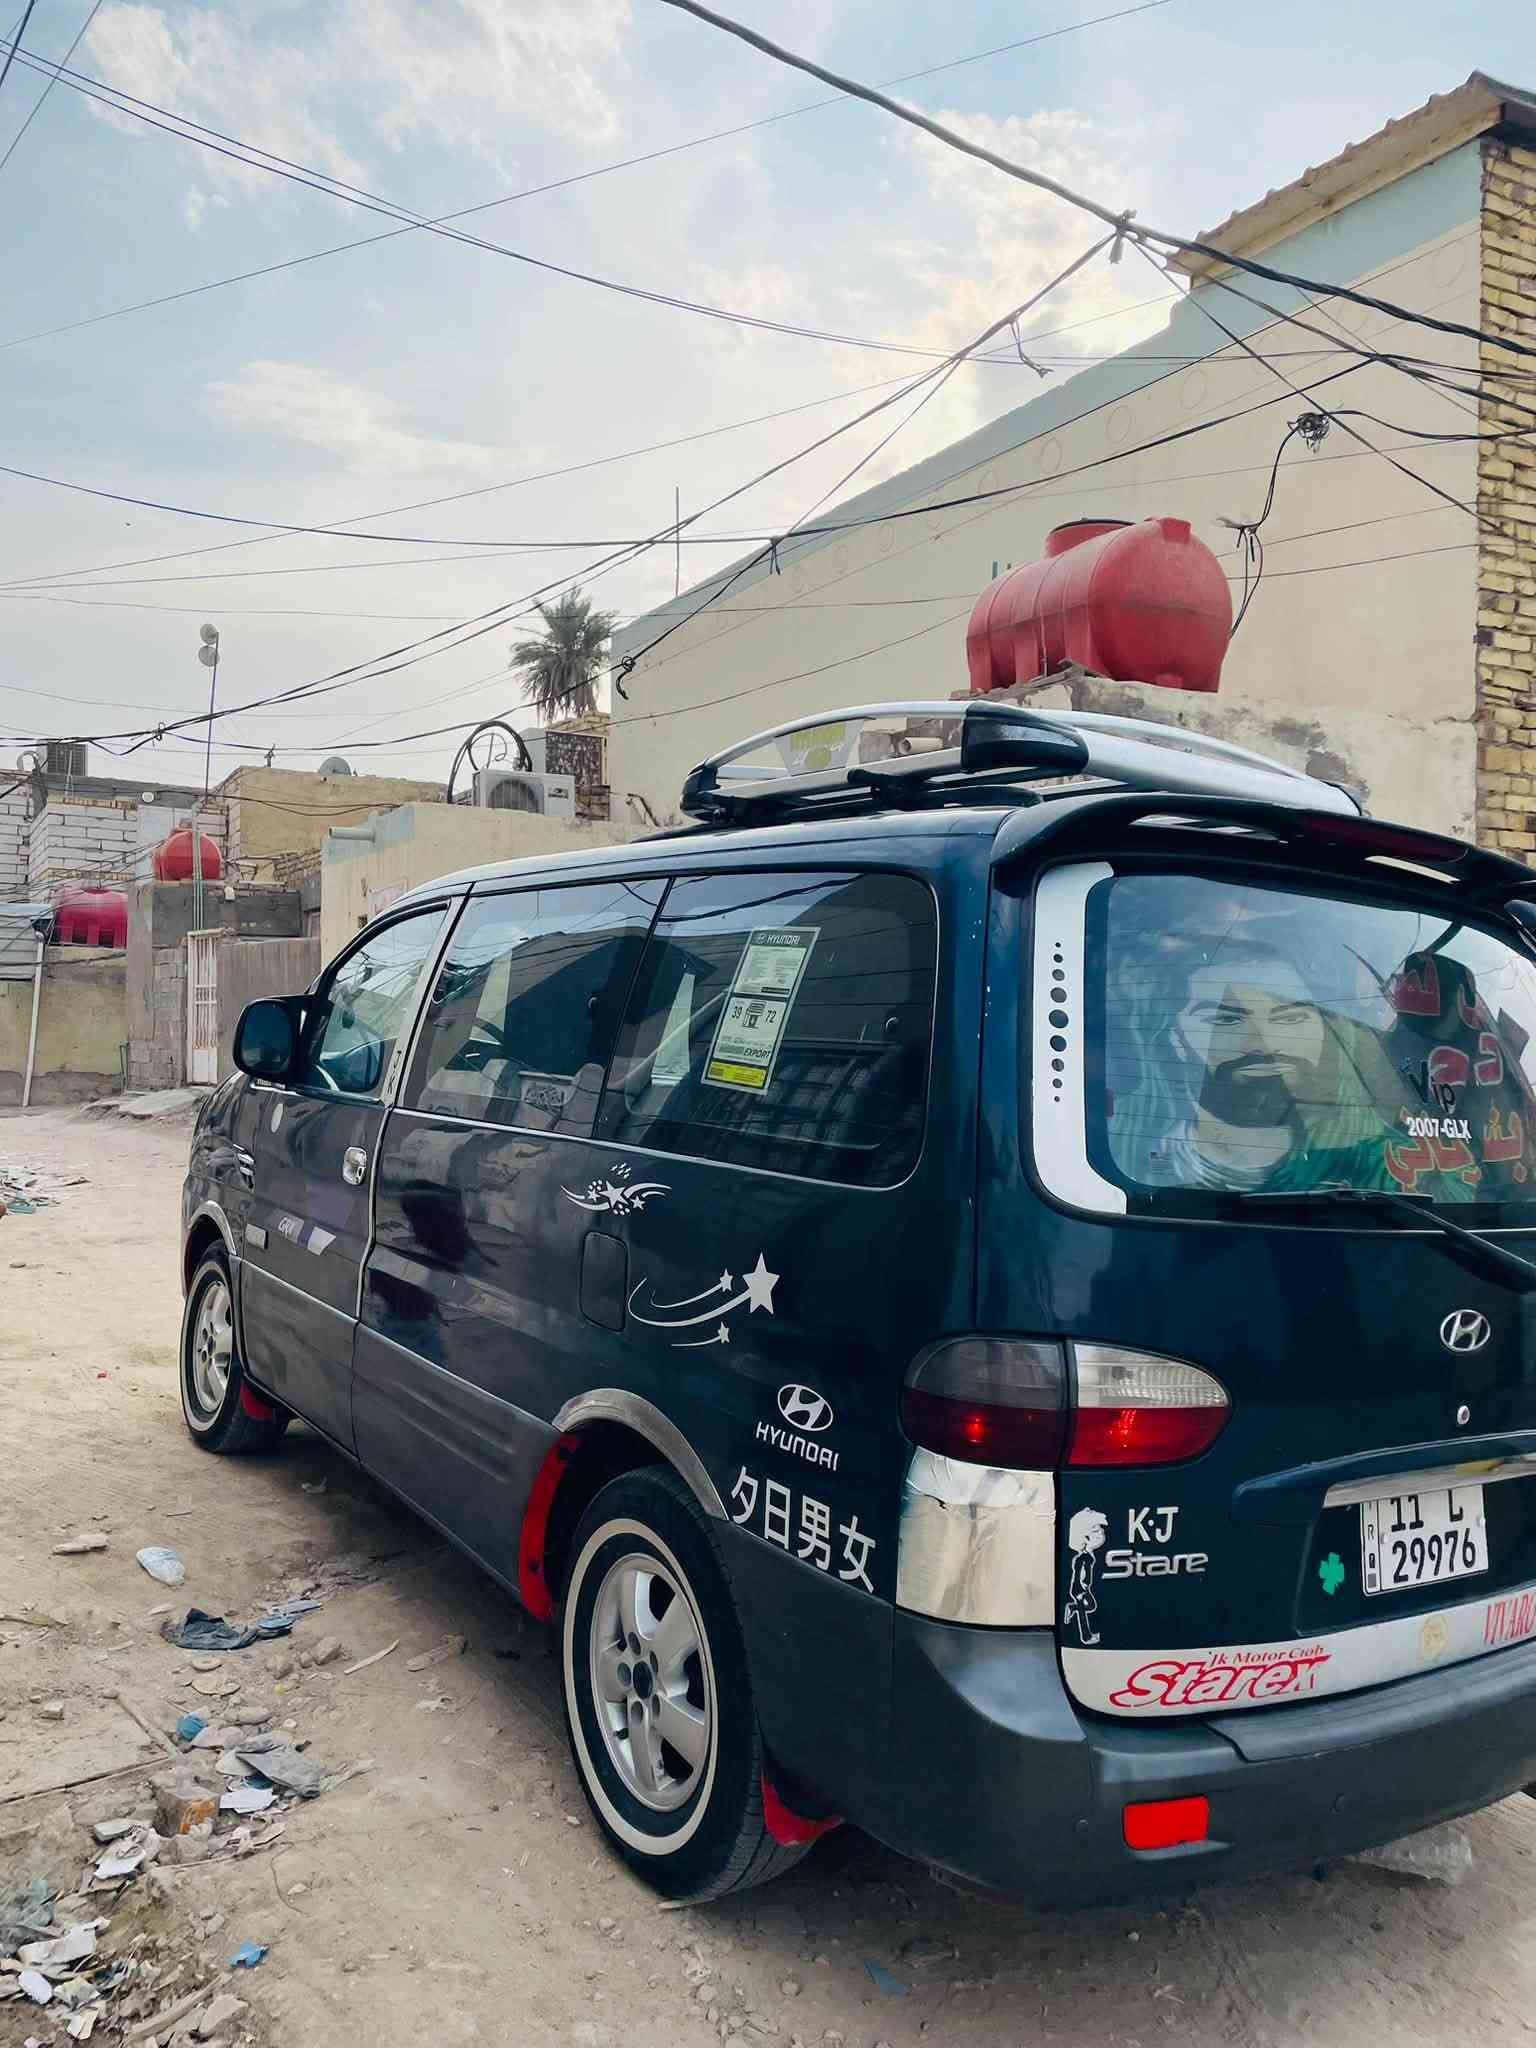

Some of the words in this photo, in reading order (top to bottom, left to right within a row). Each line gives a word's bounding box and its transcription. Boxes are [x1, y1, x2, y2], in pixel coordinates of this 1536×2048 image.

[765, 1009, 777, 1024] 72
[1406, 1116, 1473, 1141] 2007-GLX
[755, 1420, 840, 1472] HYUNDAI
[730, 1465, 877, 1594] 夕日男女
[1390, 1494, 1425, 1533] 11
[1101, 1549, 1209, 1580] Stare
[1391, 1527, 1477, 1584] 29976
[1233, 1651, 1286, 1664] Motor
[1108, 1655, 1333, 1708] Starex
